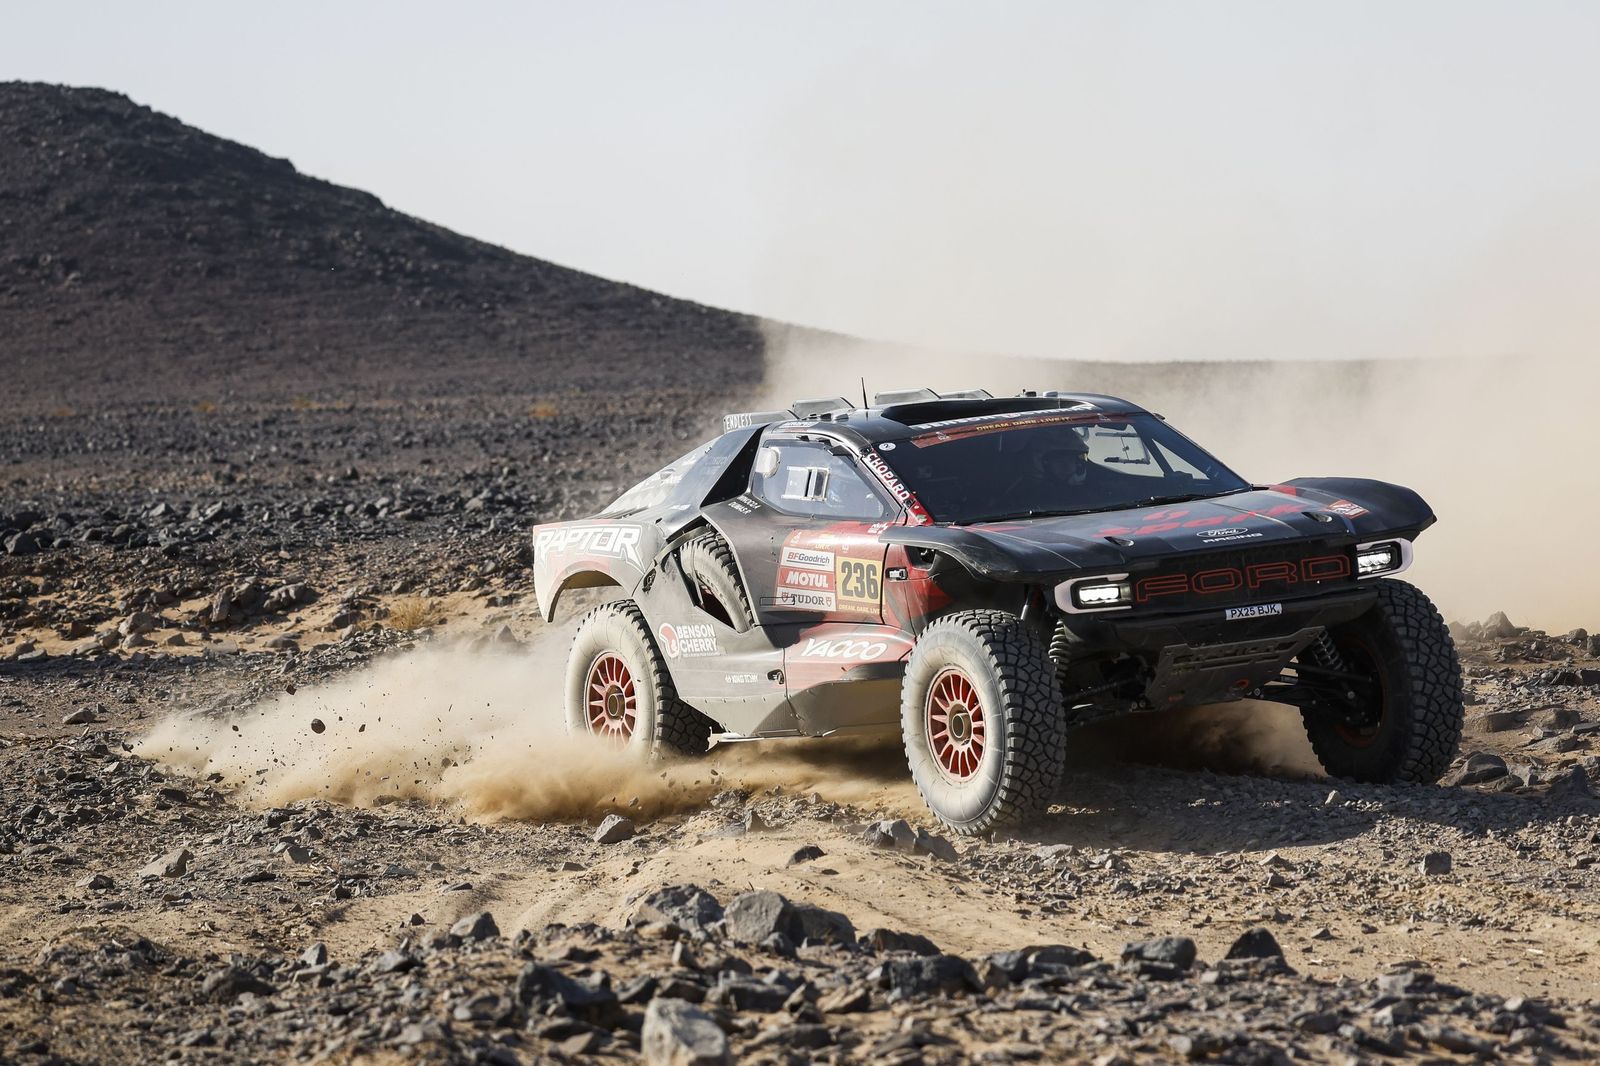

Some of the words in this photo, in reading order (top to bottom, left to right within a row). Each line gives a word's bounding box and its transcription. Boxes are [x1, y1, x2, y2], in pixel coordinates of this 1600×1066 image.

[725, 413, 752, 430] ENDLESS
[867, 452, 910, 502] CHOPARD
[1202, 532, 1263, 544] RACING
[1206, 527, 1241, 537] Ford
[534, 526, 644, 574] RAPTOR
[787, 551, 830, 564] BFGoodrich
[785, 571, 828, 588] MOTUL
[841, 561, 879, 600] 236
[1136, 554, 1350, 603] FORD
[791, 593, 825, 606] TUDOR
[1231, 607, 1255, 618] PX25
[1257, 604, 1278, 615] BJK
[676, 623, 716, 639] BENSON
[680, 637, 717, 653] CHERRY
[800, 638, 887, 660] YACCO
